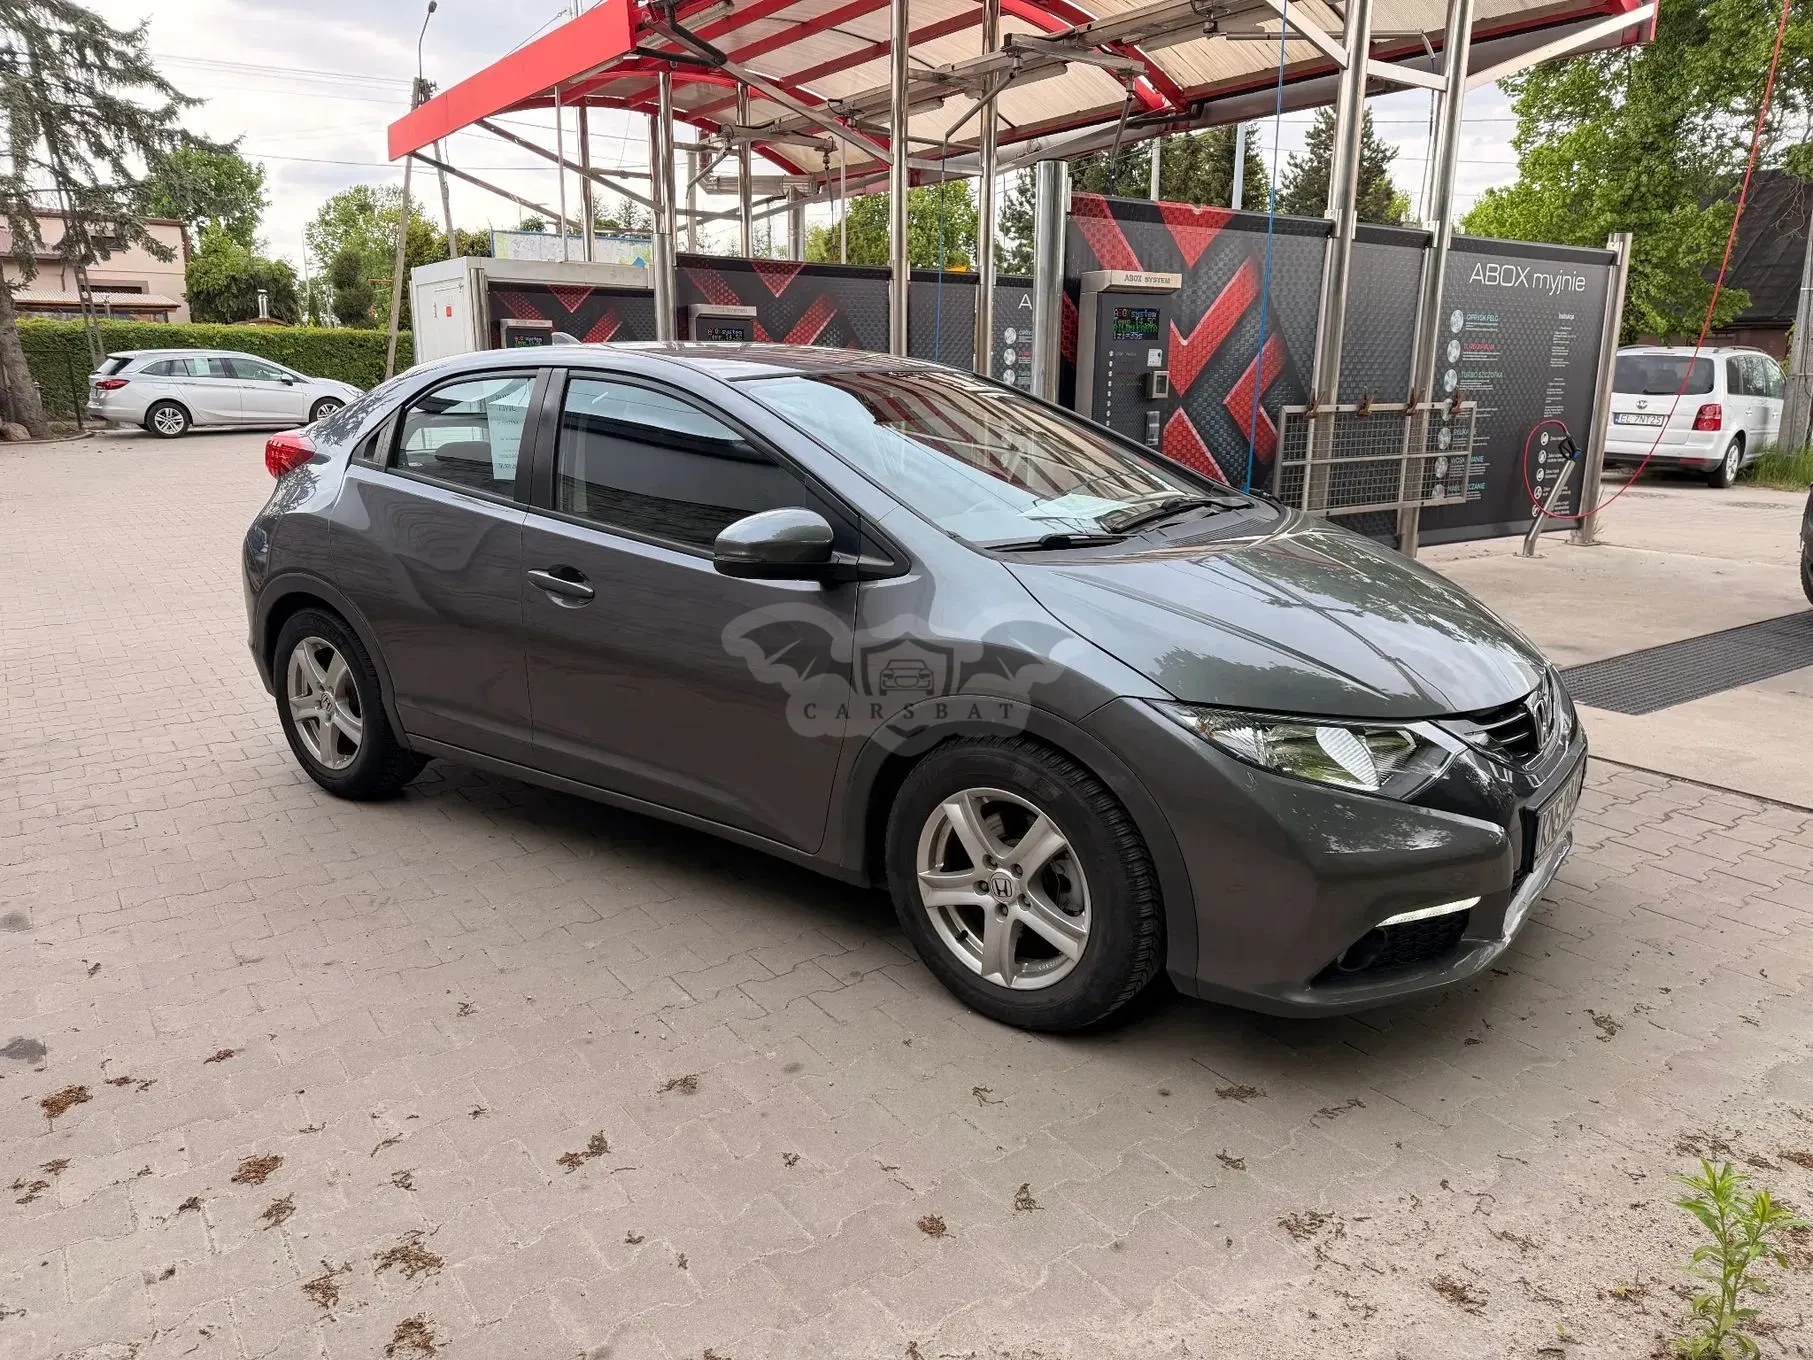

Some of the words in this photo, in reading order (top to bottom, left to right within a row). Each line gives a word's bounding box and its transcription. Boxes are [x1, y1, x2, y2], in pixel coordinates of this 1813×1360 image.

[1124, 274, 1142, 282] ABOX
[1144, 276, 1171, 284] SYSTEM
[1469, 262, 1530, 288] ABOX
[1532, 269, 1586, 296] myjnie
[1621, 414, 1631, 423] EL
[1634, 415, 1662, 425] 7NT25
